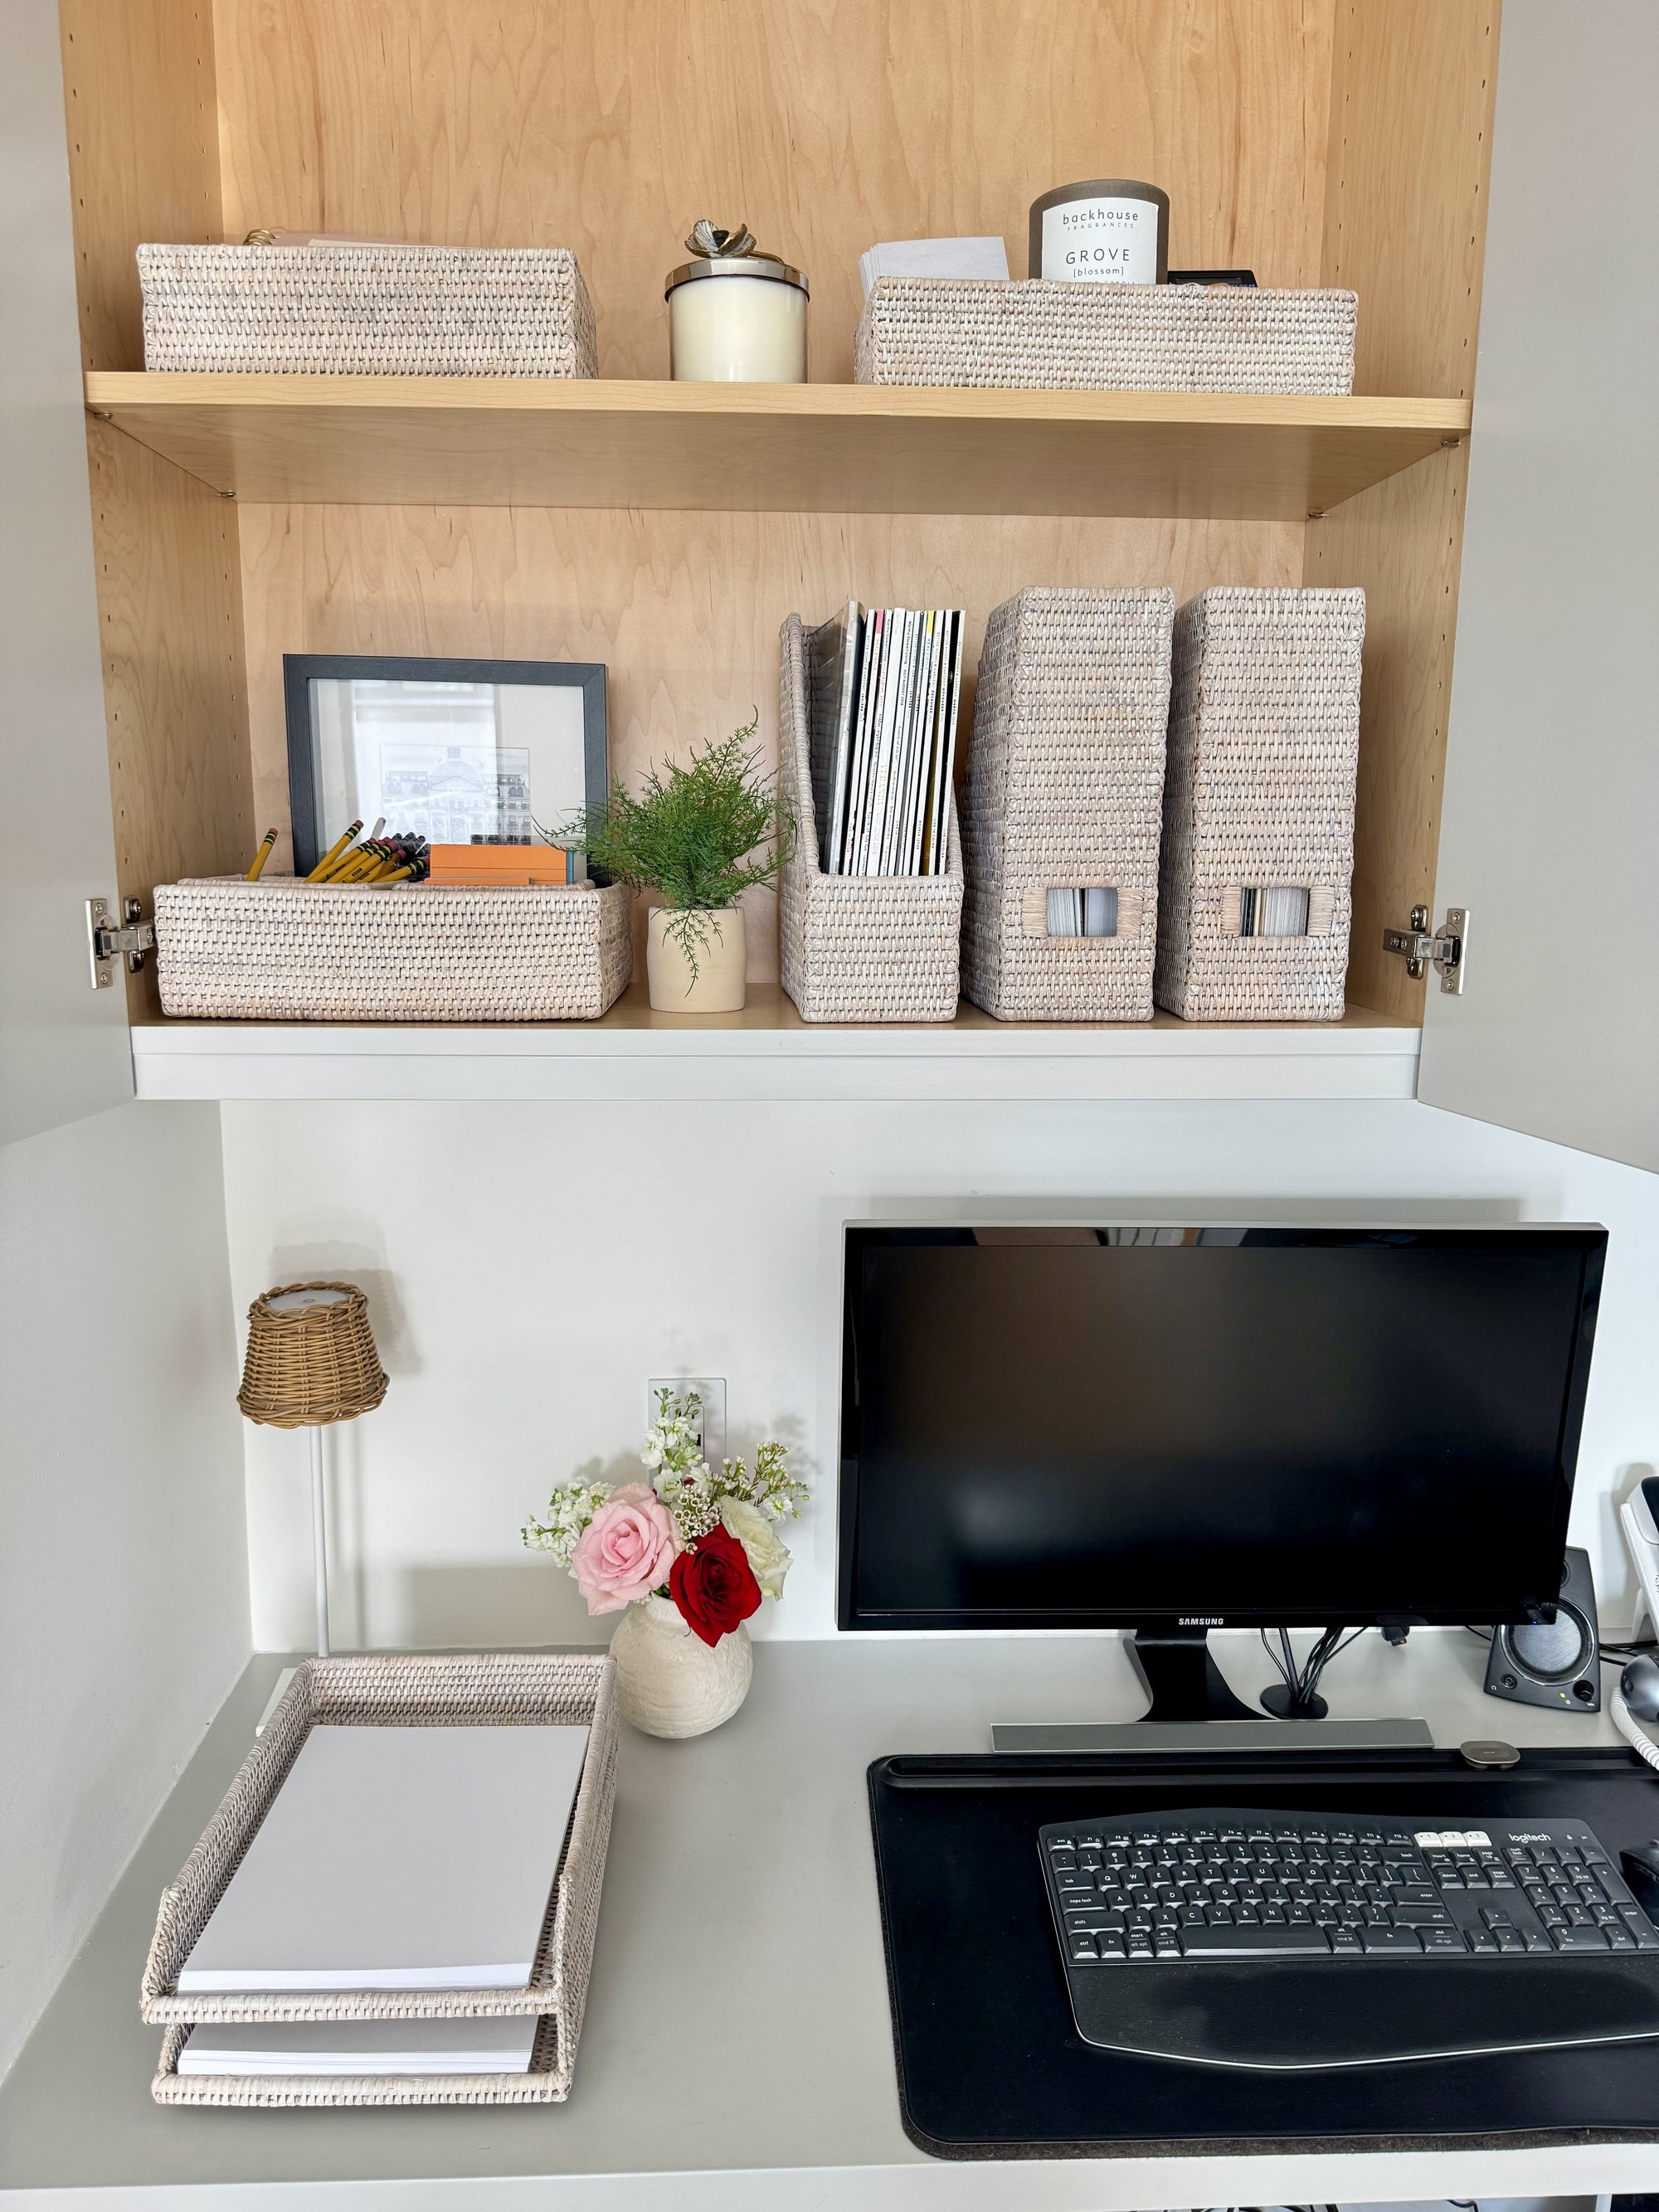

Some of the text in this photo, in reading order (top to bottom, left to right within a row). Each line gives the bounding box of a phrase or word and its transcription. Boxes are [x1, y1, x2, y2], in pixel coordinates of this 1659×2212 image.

[1063, 207, 1138, 225] backhouse
[1067, 222, 1134, 231] FRAGRANCES
[1066, 248, 1130, 265] GROVE
[1073, 266, 1124, 278] [blossom]
[1178, 1617, 1224, 1626] SAMSUNG
[1508, 1833, 1551, 1844] logitech
